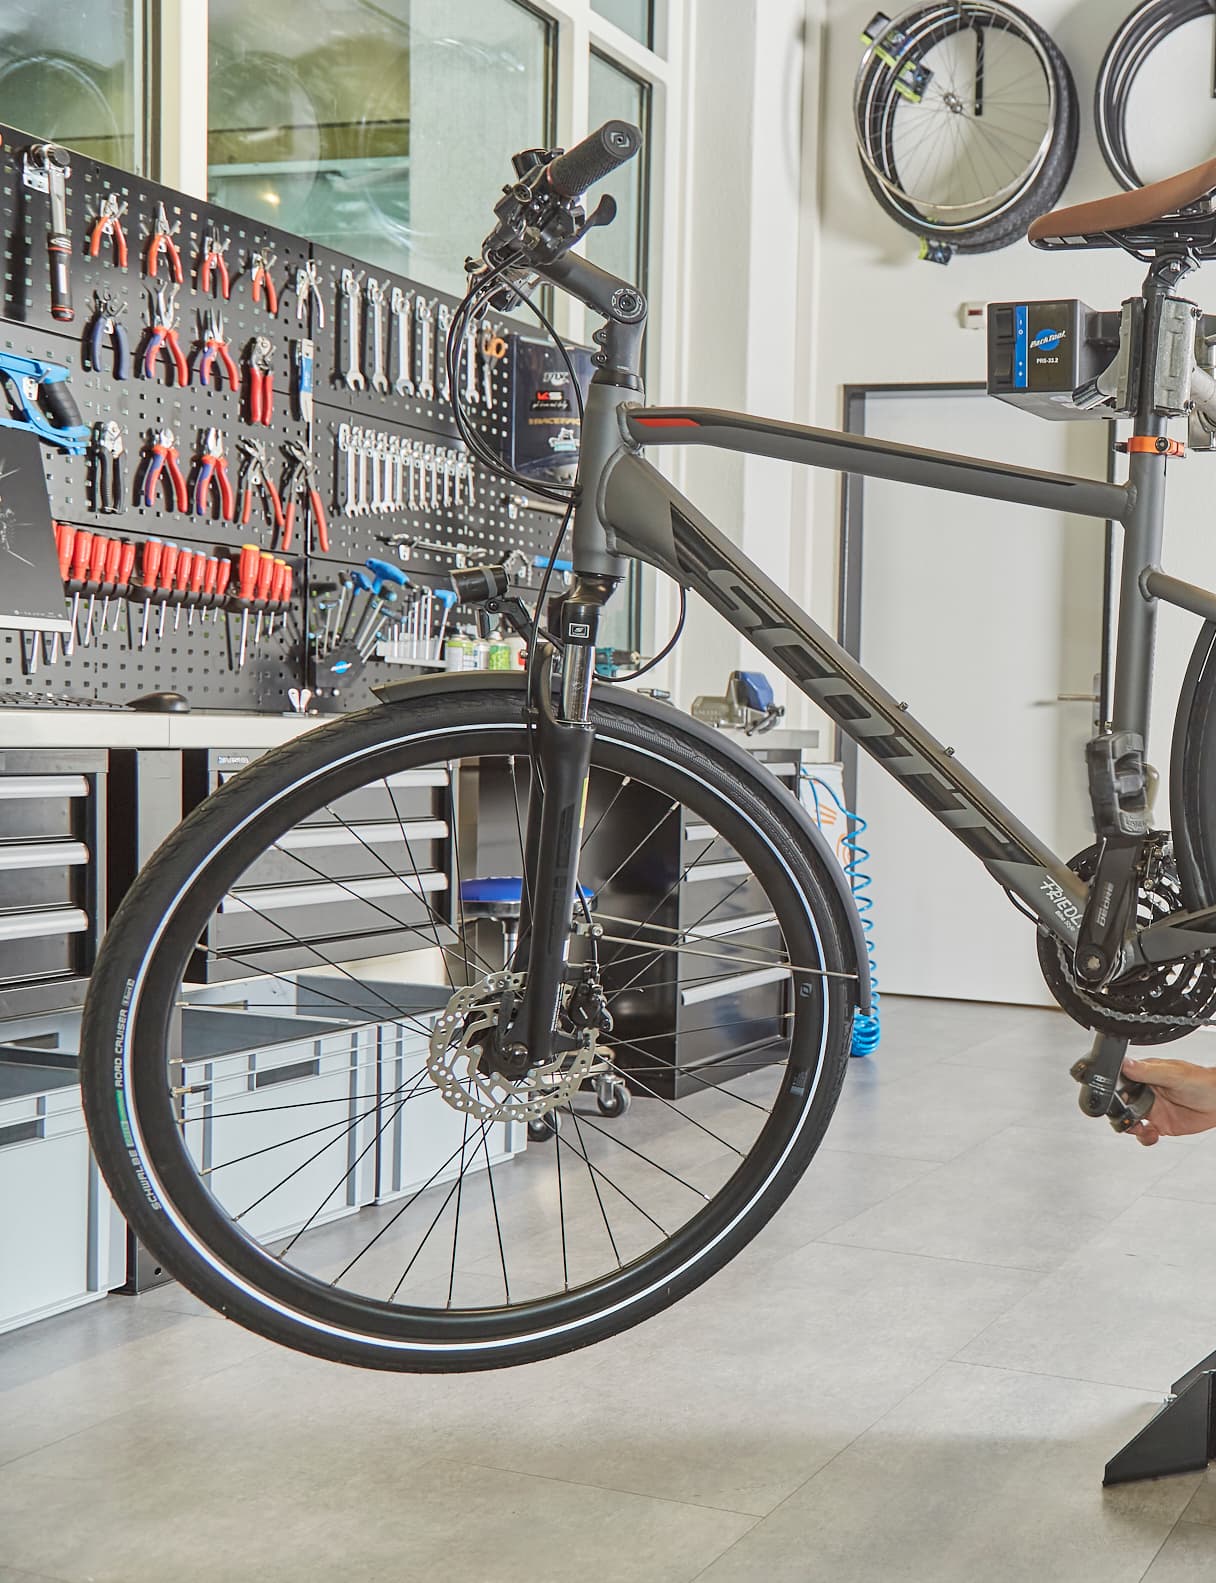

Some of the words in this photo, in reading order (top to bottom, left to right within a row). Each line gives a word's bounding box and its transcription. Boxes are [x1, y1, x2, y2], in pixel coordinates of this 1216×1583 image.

[707, 569, 1011, 845] SCOTT
[114, 1008, 129, 1054] CRUISER
[114, 1057, 124, 1088] ROAD
[128, 1149, 162, 1211] SCHWALBE
